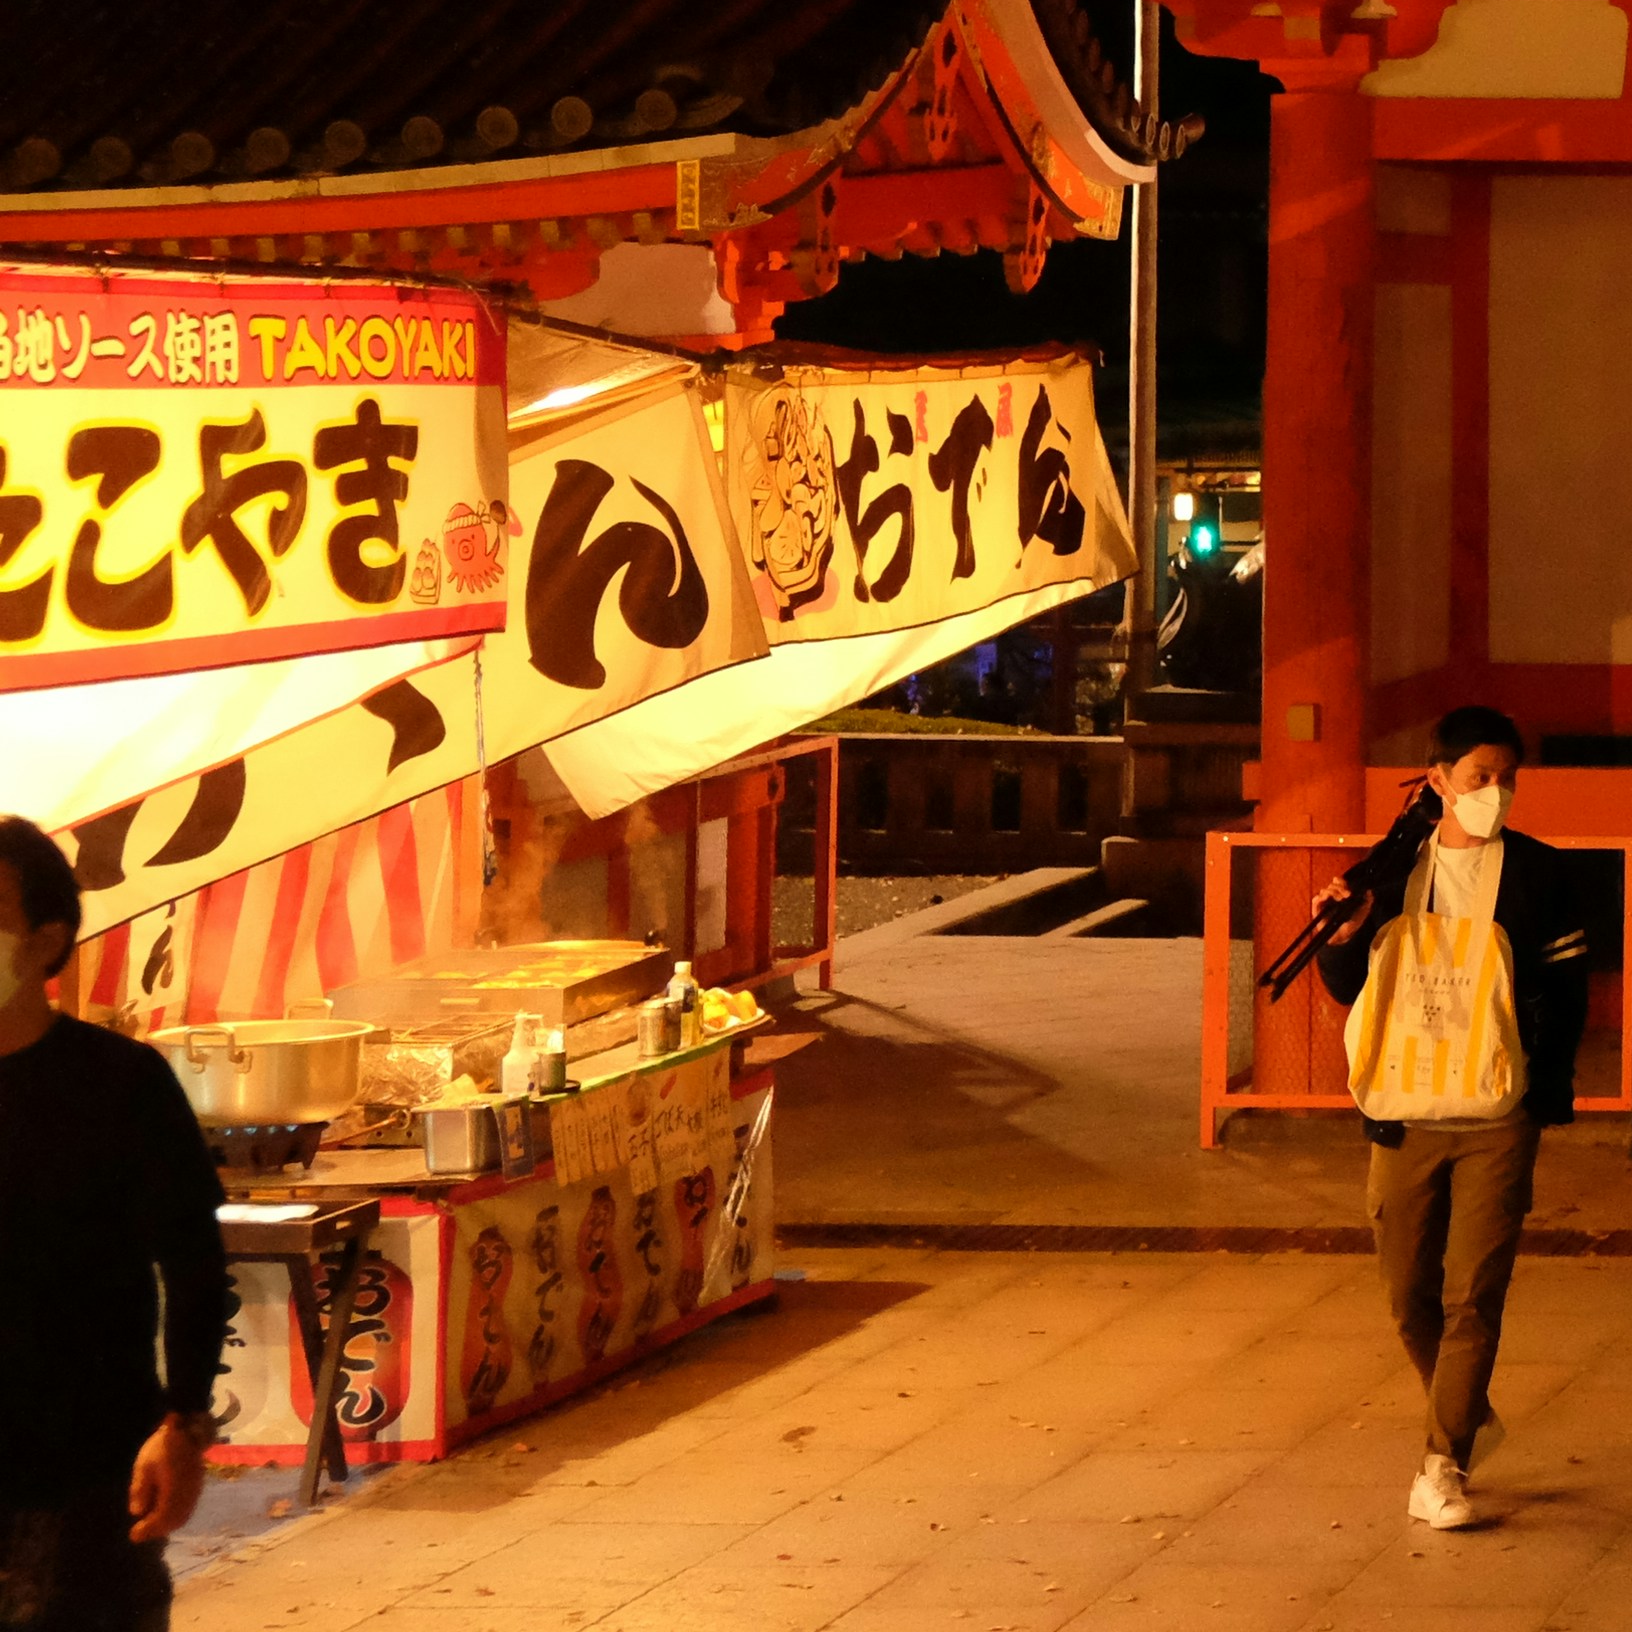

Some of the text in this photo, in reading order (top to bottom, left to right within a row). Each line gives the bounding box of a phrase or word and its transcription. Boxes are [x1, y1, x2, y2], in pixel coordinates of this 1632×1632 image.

[249, 314, 475, 380] TAKOYAKI
[834, 383, 1085, 603] おでん
